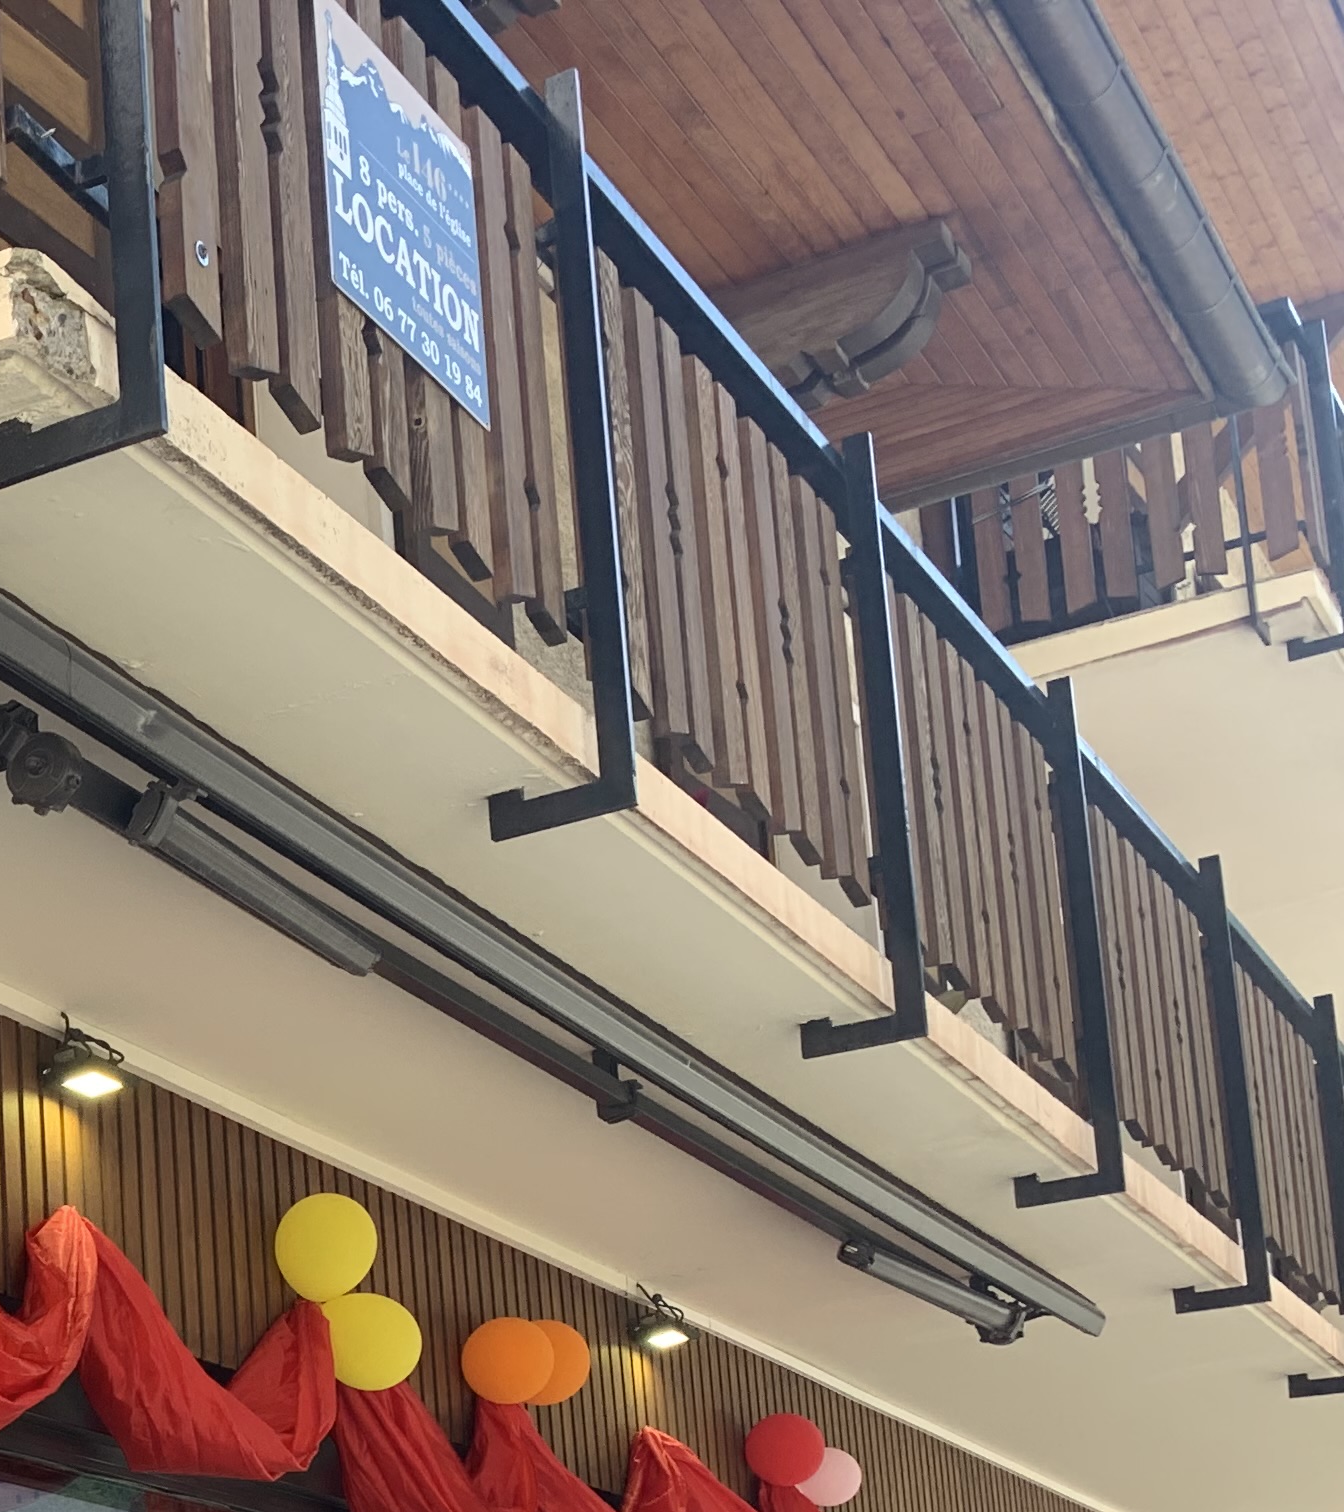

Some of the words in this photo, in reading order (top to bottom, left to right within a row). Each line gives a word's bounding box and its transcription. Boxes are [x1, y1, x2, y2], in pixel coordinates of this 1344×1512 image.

[358, 154, 371, 185] 8
[377, 174, 421, 238] pers.
[422, 224, 432, 250] 5
[436, 238, 478, 297] pièces
[397, 161, 425, 198] place
[425, 189, 439, 214] de
[412, 142, 448, 203] 146
[332, 168, 480, 354] LOCATION
[338, 251, 370, 301] Tél.
[373, 288, 394, 320] 06
[397, 309, 417, 344] 77
[421, 331, 441, 366] 30
[445, 353, 461, 386] 19
[465, 374, 483, 408] 84
